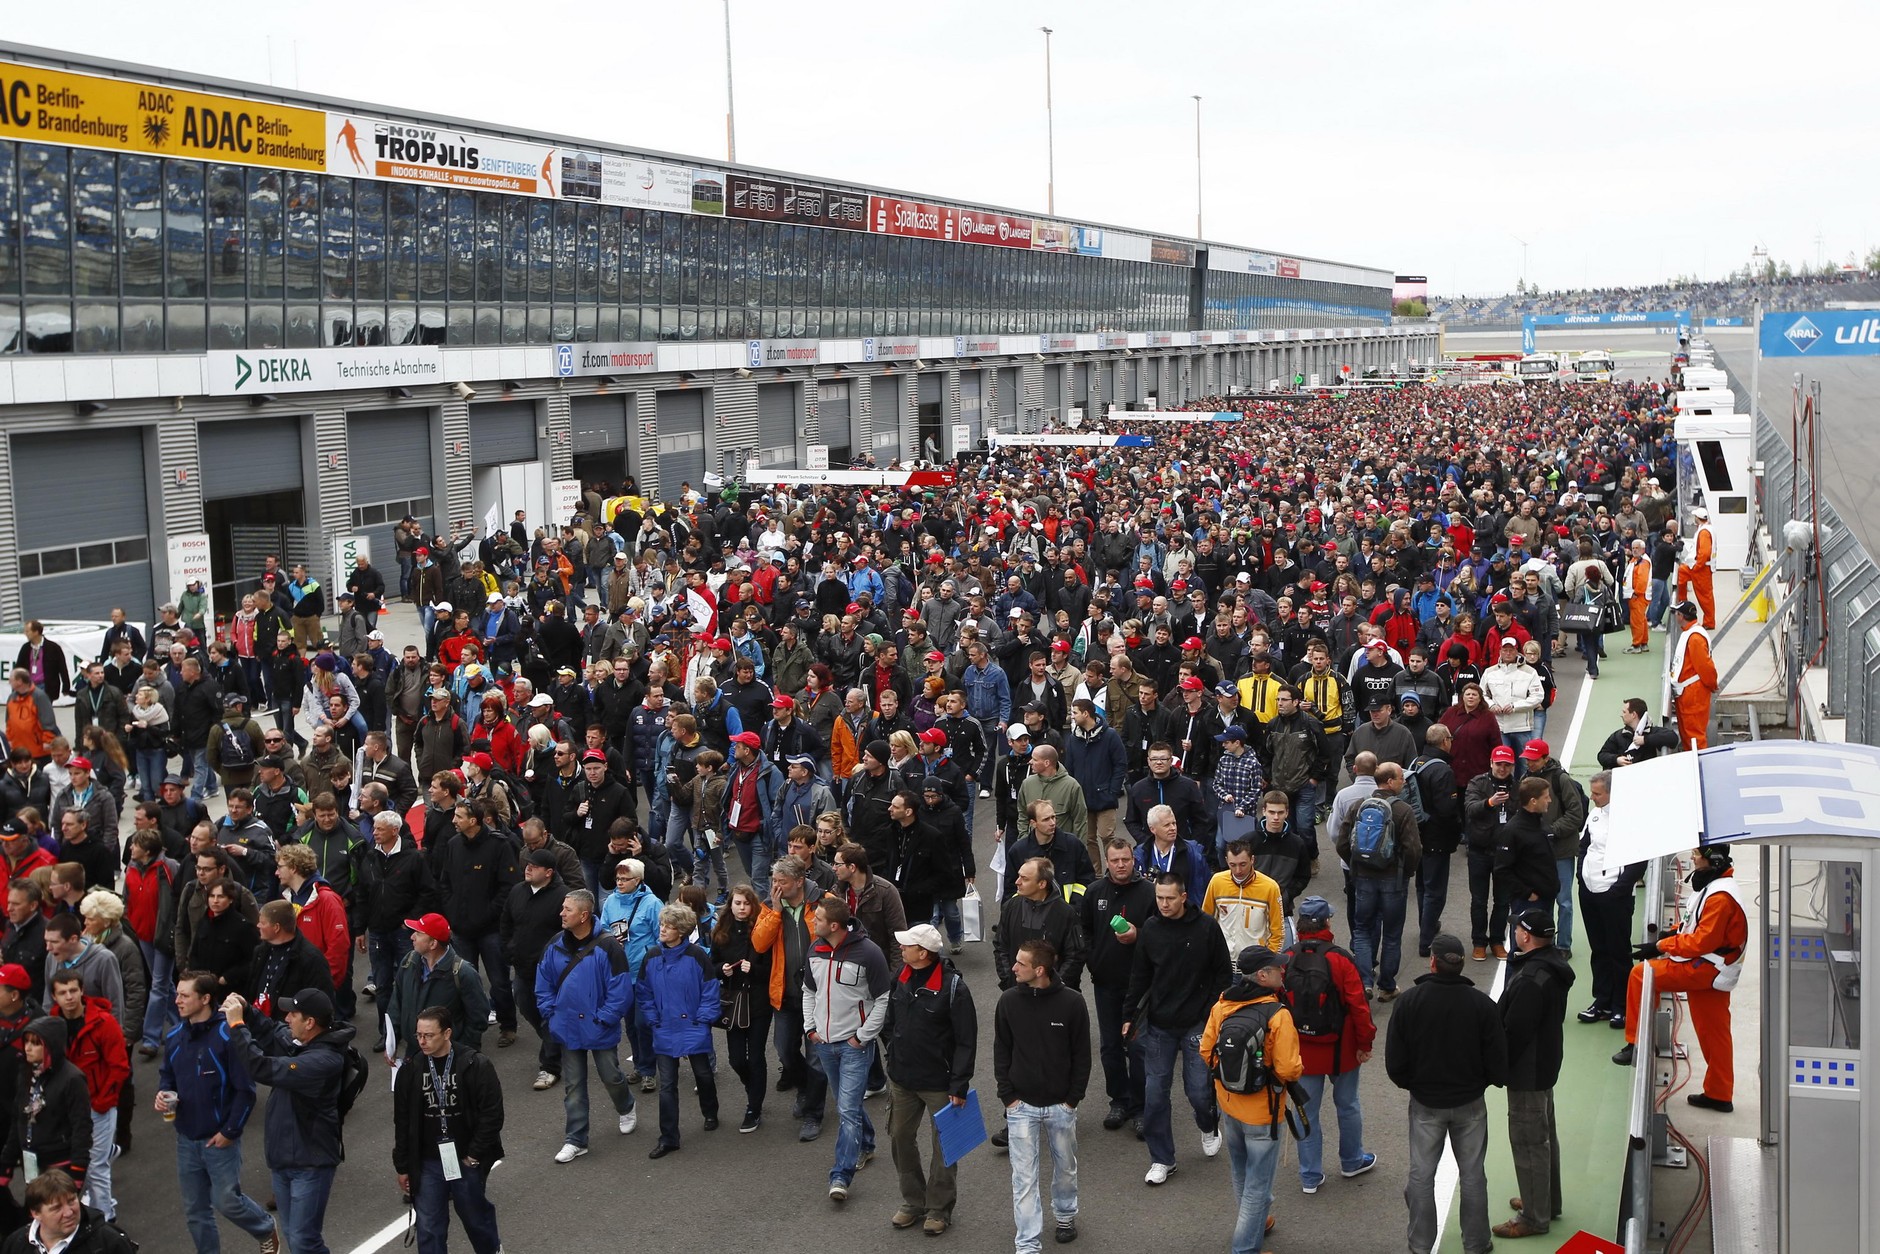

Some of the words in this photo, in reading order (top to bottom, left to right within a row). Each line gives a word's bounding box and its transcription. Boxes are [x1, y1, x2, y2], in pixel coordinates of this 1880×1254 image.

[37, 84, 84, 109] Berlin-
[138, 90, 174, 114] ADAC
[38, 110, 128, 143] Brandenburg
[181, 106, 252, 153] ADAC
[257, 116, 292, 137] Berlin-
[375, 124, 436, 141] SNOW
[257, 140, 325, 165] Brandenburg
[482, 157, 537, 177] SENFTENBERG
[391, 165, 418, 178] INDOOR
[419, 169, 449, 182] SKIHALLE
[453, 174, 520, 190] www.snowtropolis.de
[750, 192, 776, 211] F60
[797, 198, 820, 217] F60
[842, 204, 862, 222] F60
[894, 204, 938, 232] Sparkasse
[972, 224, 996, 236] LANGNESE
[1010, 228, 1031, 240] LANGNESE
[1790, 330, 1816, 338] ARAL
[560, 352, 572, 367] ZF
[582, 350, 654, 369] zf.com/motorsport
[766, 345, 817, 362] zf.com/motorsport
[259, 358, 312, 383] DEKRA
[337, 360, 390, 378] Technische
[393, 358, 436, 375] Abnahme
